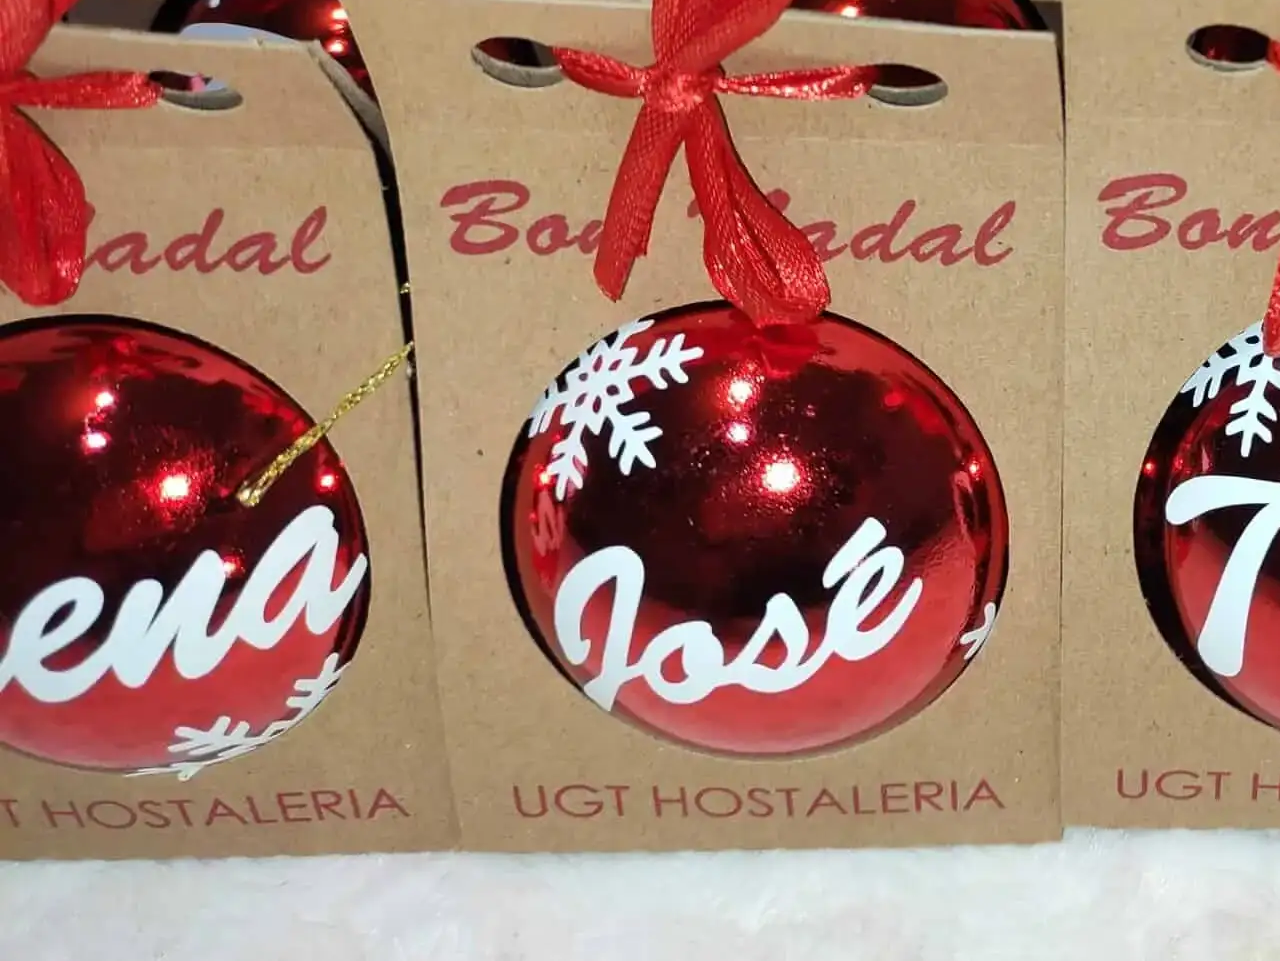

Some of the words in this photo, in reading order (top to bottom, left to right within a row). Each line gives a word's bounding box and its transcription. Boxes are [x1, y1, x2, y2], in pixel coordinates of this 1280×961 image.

[84, 201, 332, 276] adal
[687, 188, 1016, 267] adal
[553, 516, 922, 711] José
[41, 786, 410, 830] HOSTALERIA
[512, 784, 630, 819] UGT
[652, 778, 1006, 819] HOSTALERIA
[1116, 768, 1232, 802] UGT
